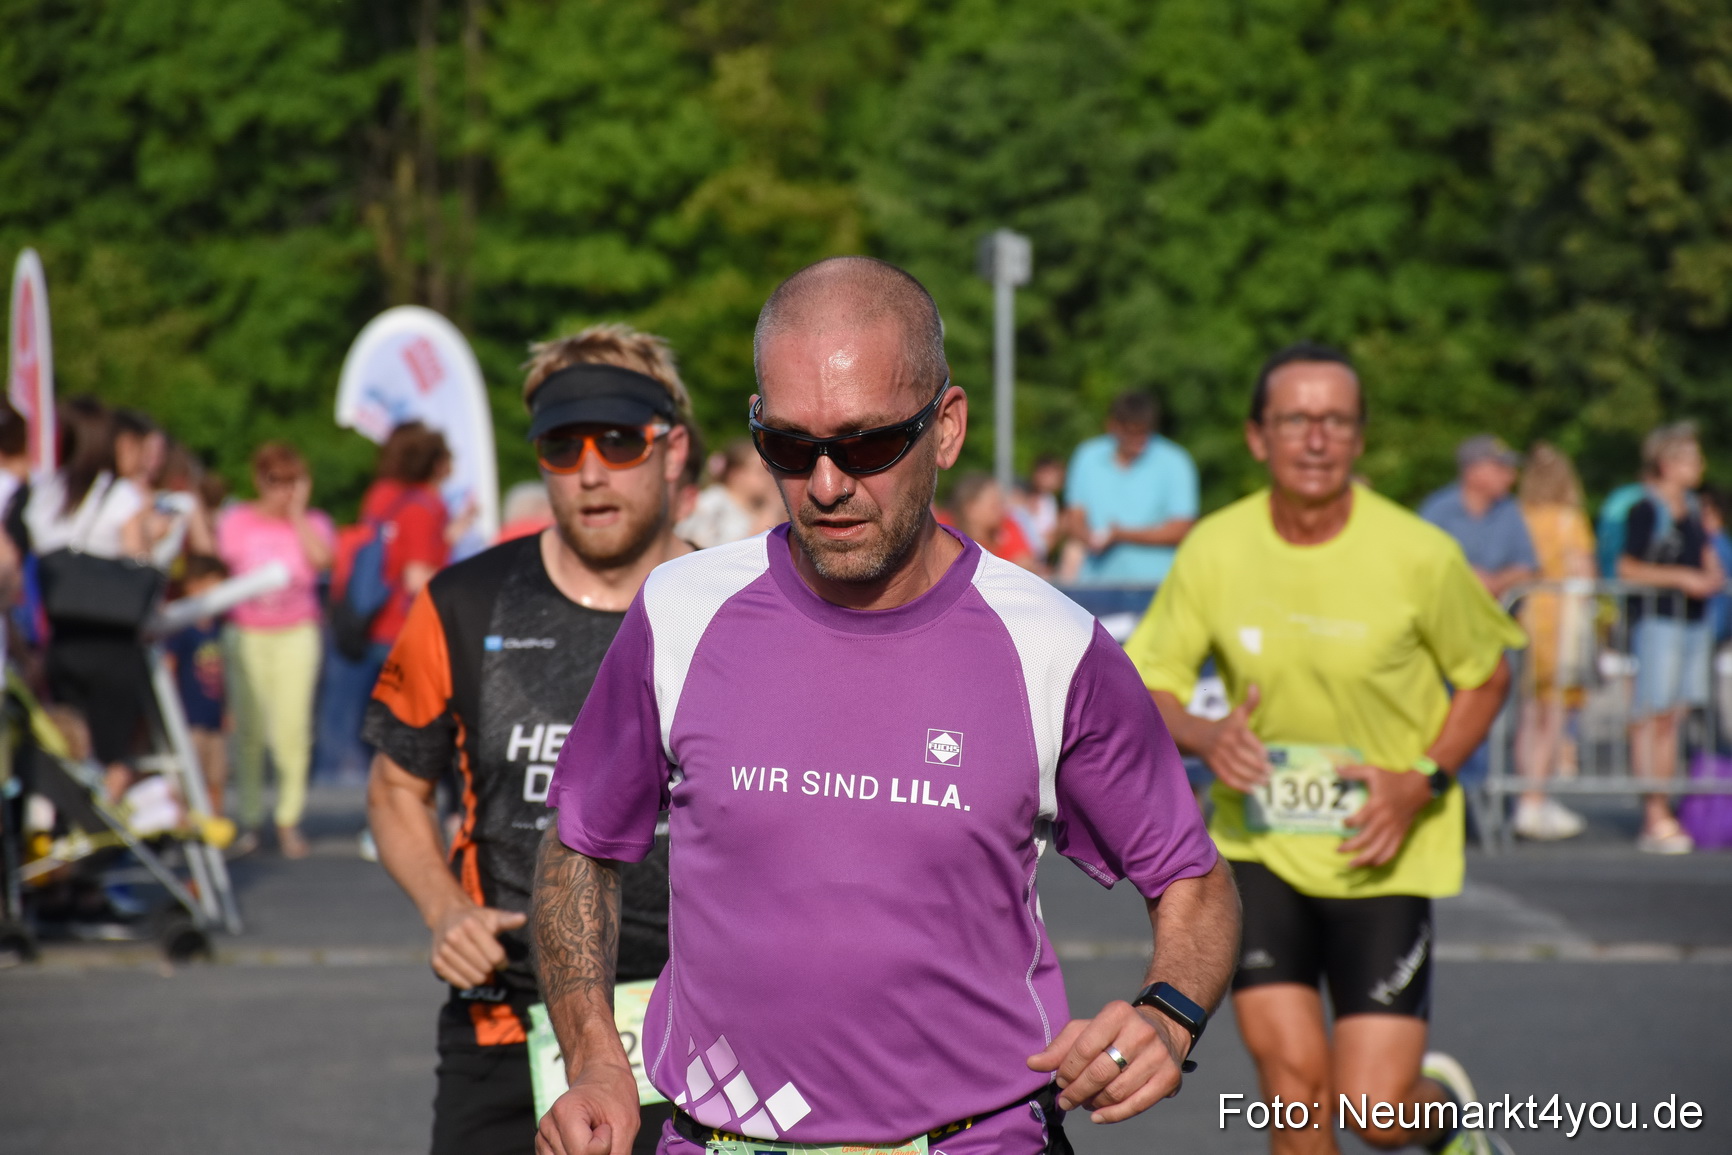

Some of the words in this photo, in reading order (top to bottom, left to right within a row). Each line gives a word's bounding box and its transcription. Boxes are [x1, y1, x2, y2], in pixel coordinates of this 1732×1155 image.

[928, 742, 960, 753] FUCHS
[731, 766, 789, 792] WIR
[801, 771, 879, 800] SIND
[890, 778, 971, 811] LILA.
